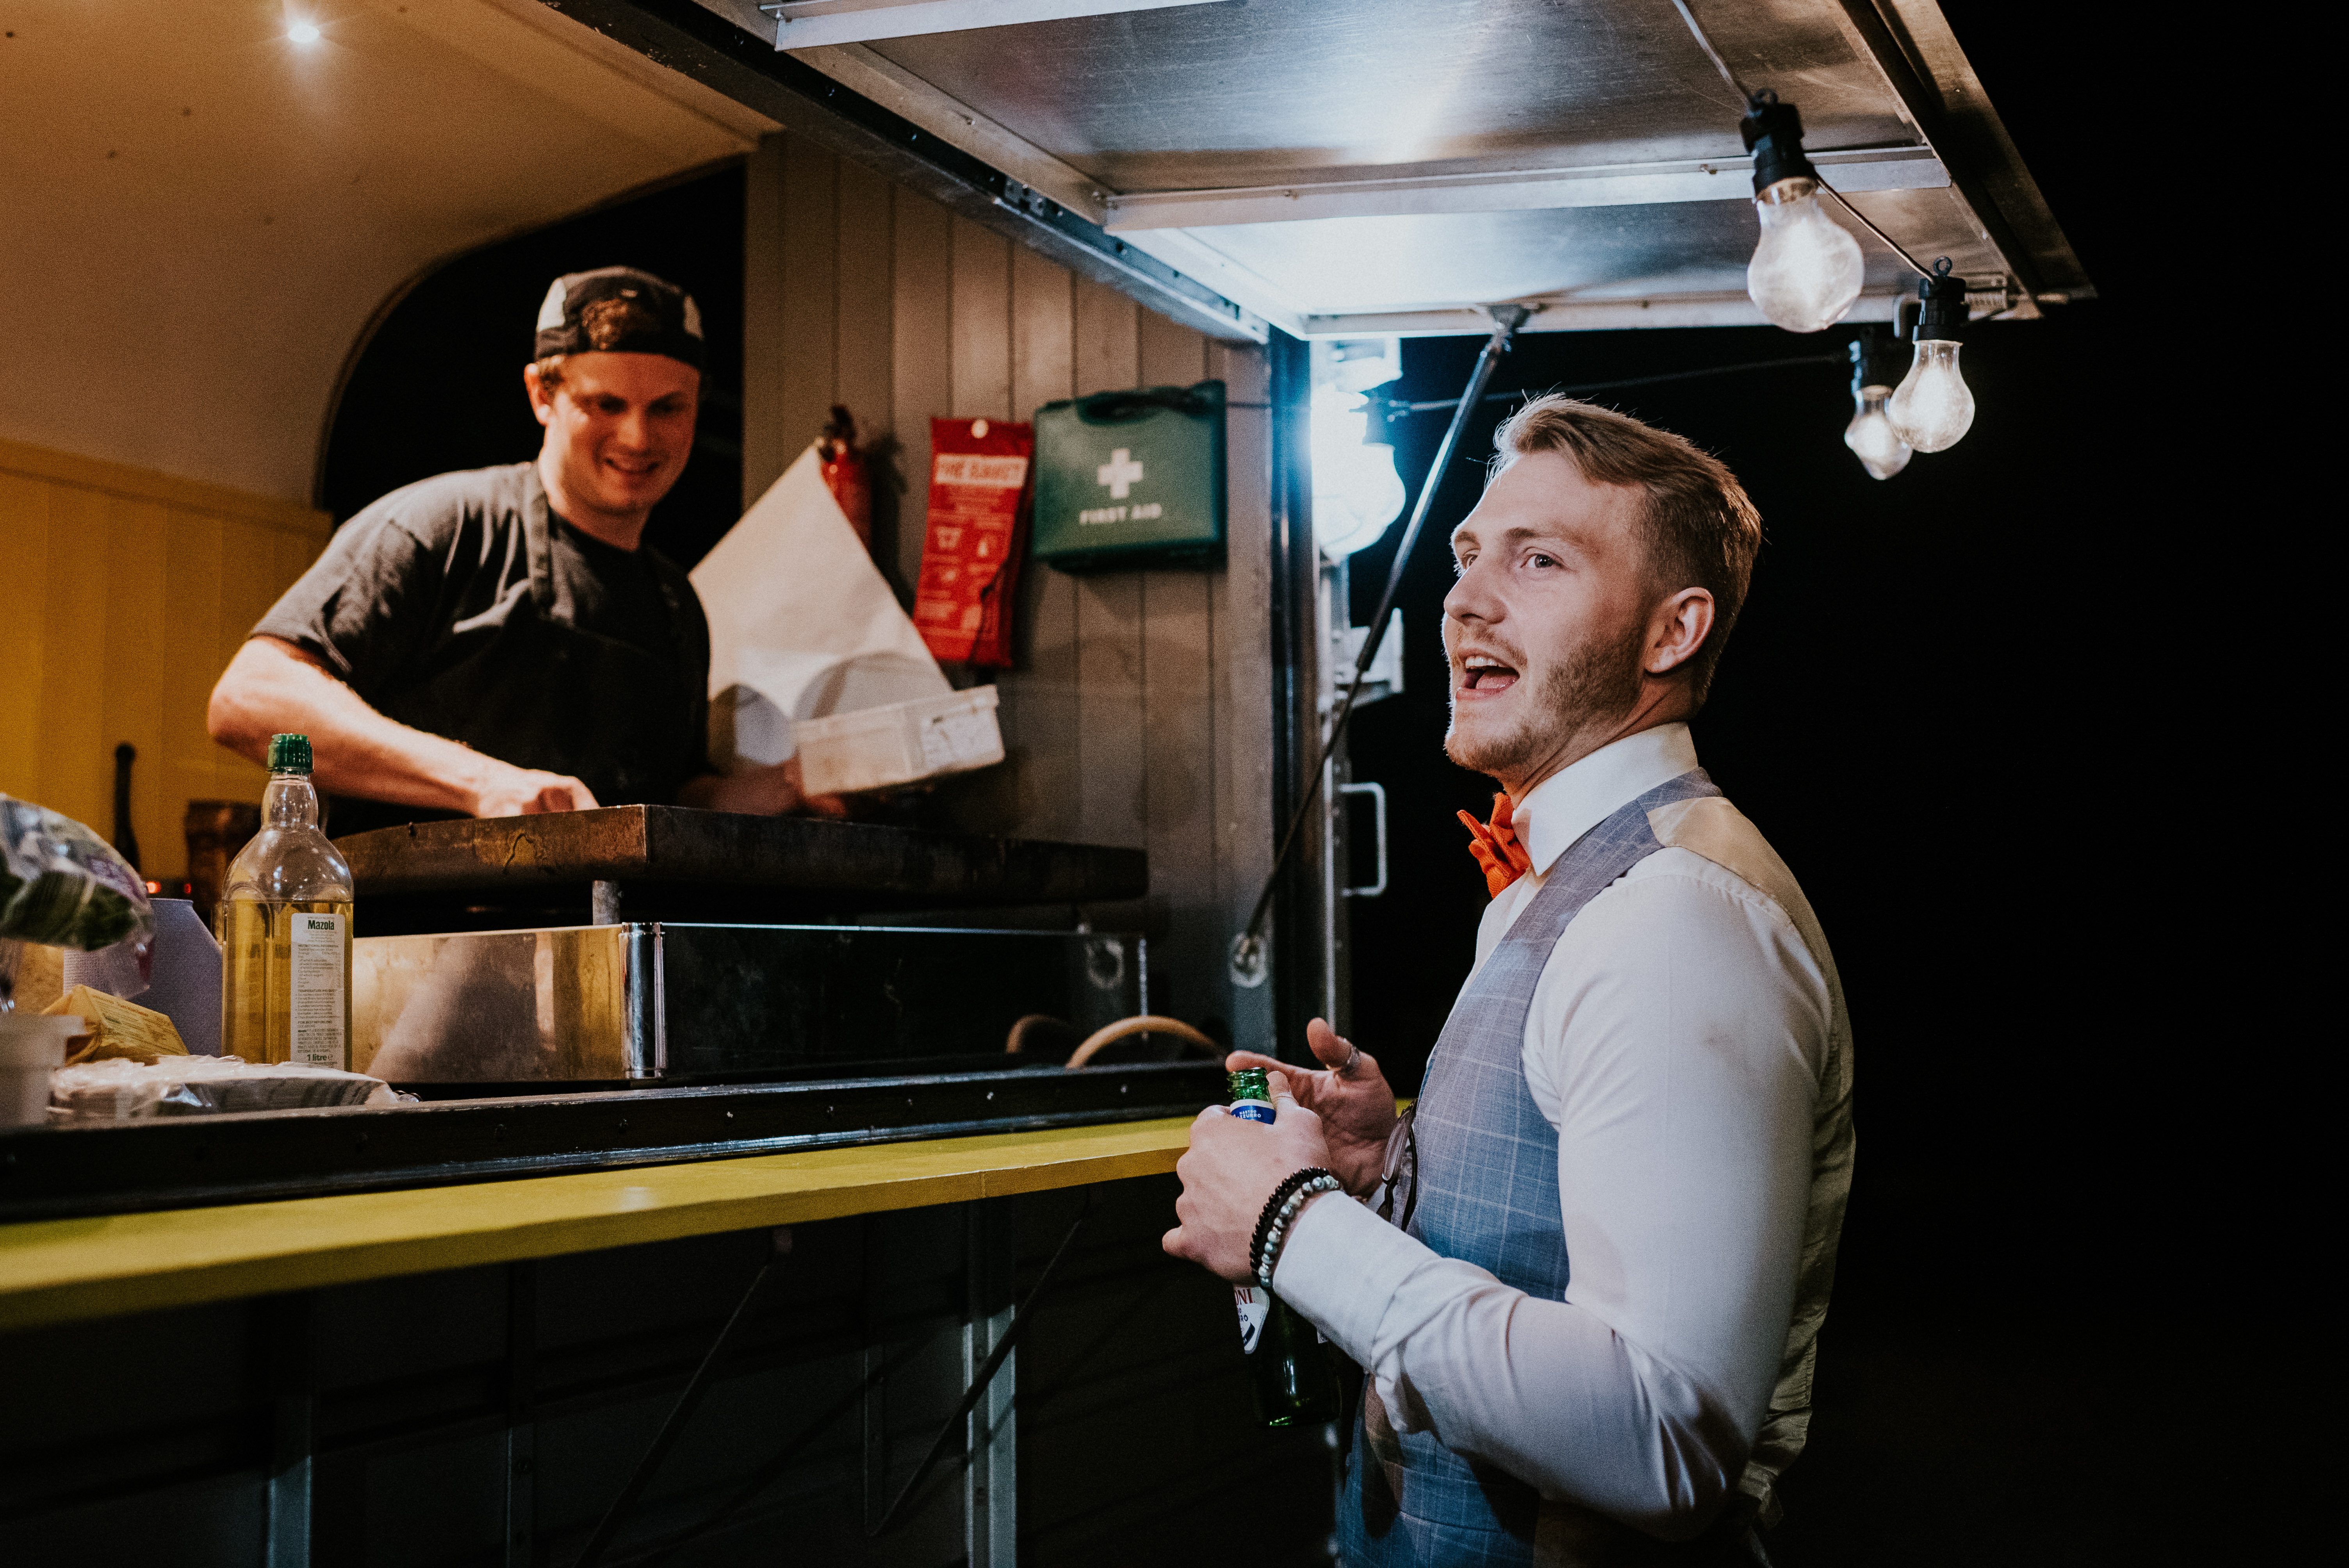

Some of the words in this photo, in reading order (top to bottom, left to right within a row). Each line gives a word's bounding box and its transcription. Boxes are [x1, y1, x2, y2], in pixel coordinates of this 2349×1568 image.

[1079, 506, 1126, 524] FIRST
[1132, 503, 1162, 519] AID
[308, 920, 335, 930] Mazola
